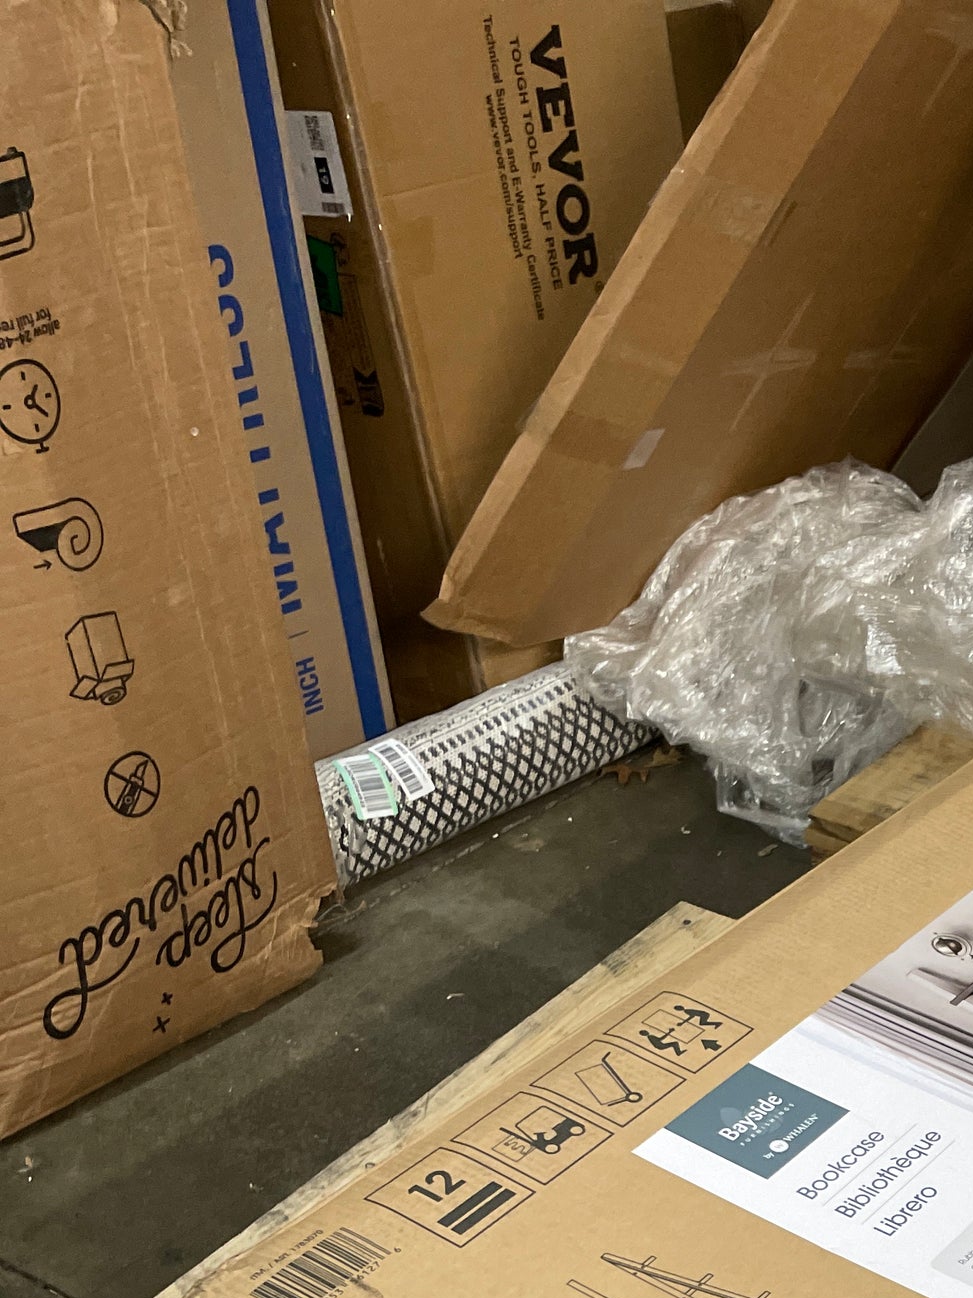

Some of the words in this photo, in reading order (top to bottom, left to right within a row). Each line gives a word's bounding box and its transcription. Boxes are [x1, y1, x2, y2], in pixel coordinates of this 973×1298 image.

[482, 13, 503, 84] Technical
[494, 87, 513, 145] Support
[484, 92, 524, 259] www.vevor.com/support
[505, 147, 519, 173] and
[508, 35, 529, 105] TOUGH
[521, 109, 542, 179] TOOLS,
[534, 183, 552, 231] HALF
[544, 236, 563, 290] PRICE
[529, 24, 599, 286] VEVOR
[510, 175, 532, 252] E-Warranty
[36, 308, 51, 321] for
[526, 253, 545, 321] Certificate
[0, 319, 15, 331] re
[16, 313, 35, 331] full
[34, 319, 61, 336] allow
[295, 656, 325, 716] INCH
[43, 785, 261, 1040] delivered
[156, 837, 278, 973] sleep
[717, 1091, 783, 1141] Bayside
[739, 1102, 795, 1146] FURNISHINGS
[762, 1151, 775, 1159] by
[782, 1112, 818, 1141] WHALEN
[407, 1169, 467, 1202] 12
[795, 1130, 885, 1200] Bookcase
[833, 1130, 941, 1218] Bibliothèque
[872, 1185, 938, 1236] Librero
